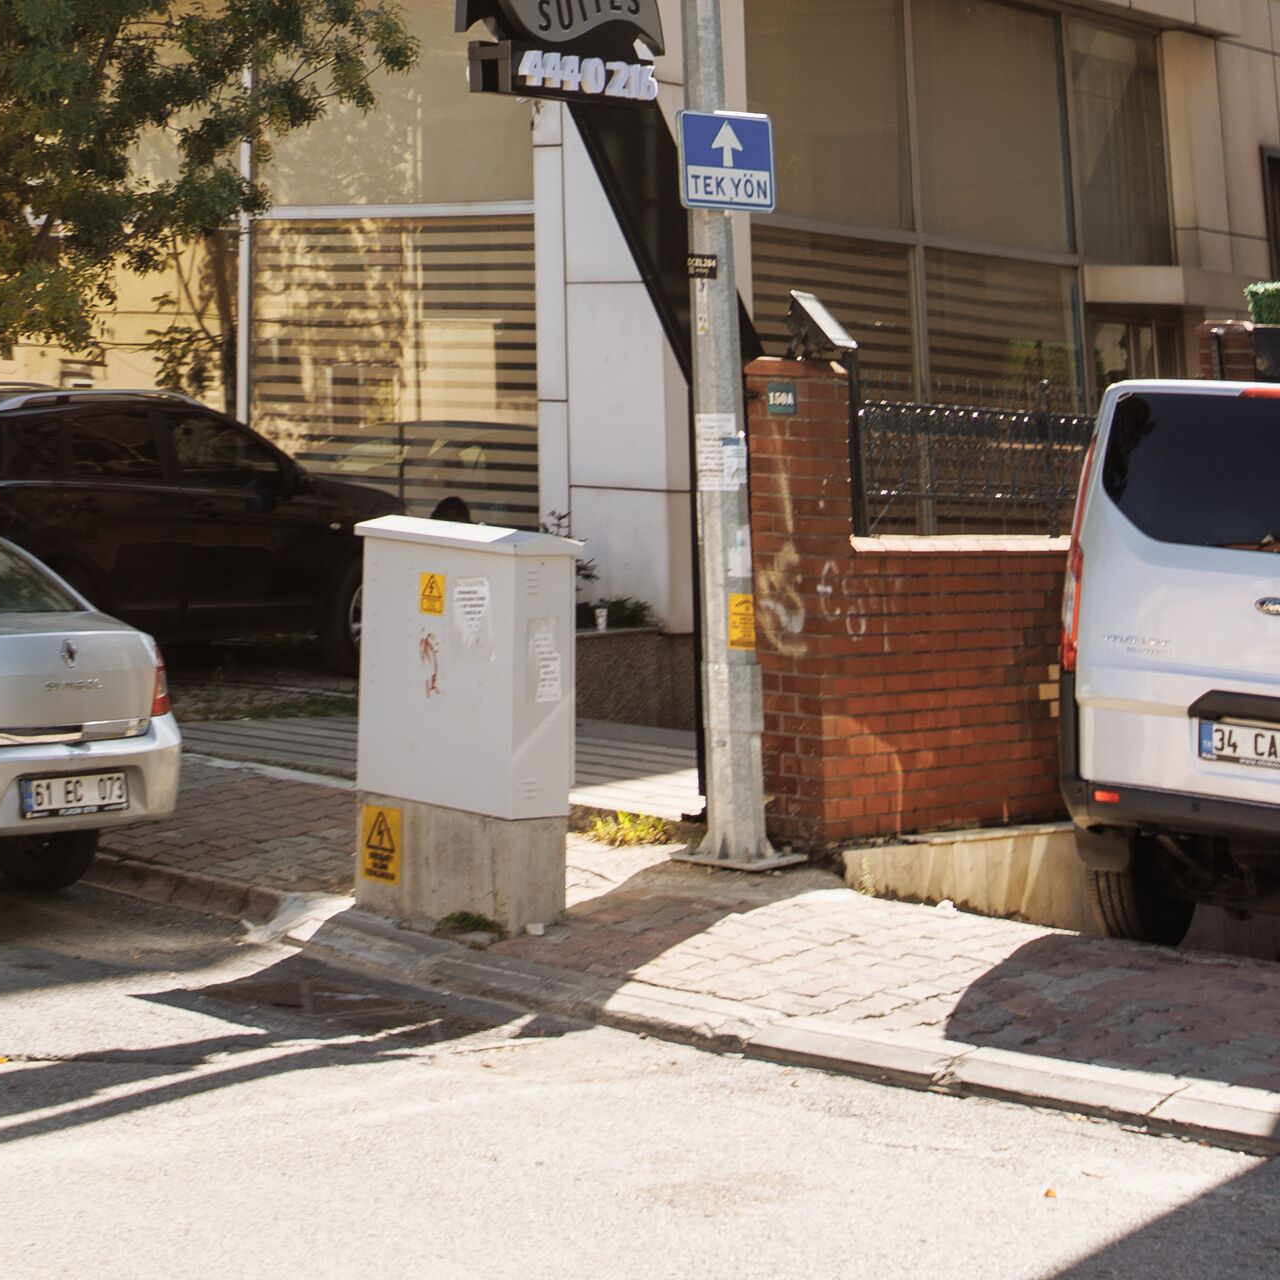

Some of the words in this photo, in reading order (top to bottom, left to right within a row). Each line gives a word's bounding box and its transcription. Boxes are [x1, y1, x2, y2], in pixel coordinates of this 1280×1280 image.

[691, 174, 726, 197] TEK
[730, 172, 768, 200] YÖN
[1213, 728, 1238, 753] 34
[35, 782, 53, 807] 61
[64, 780, 84, 804] EC
